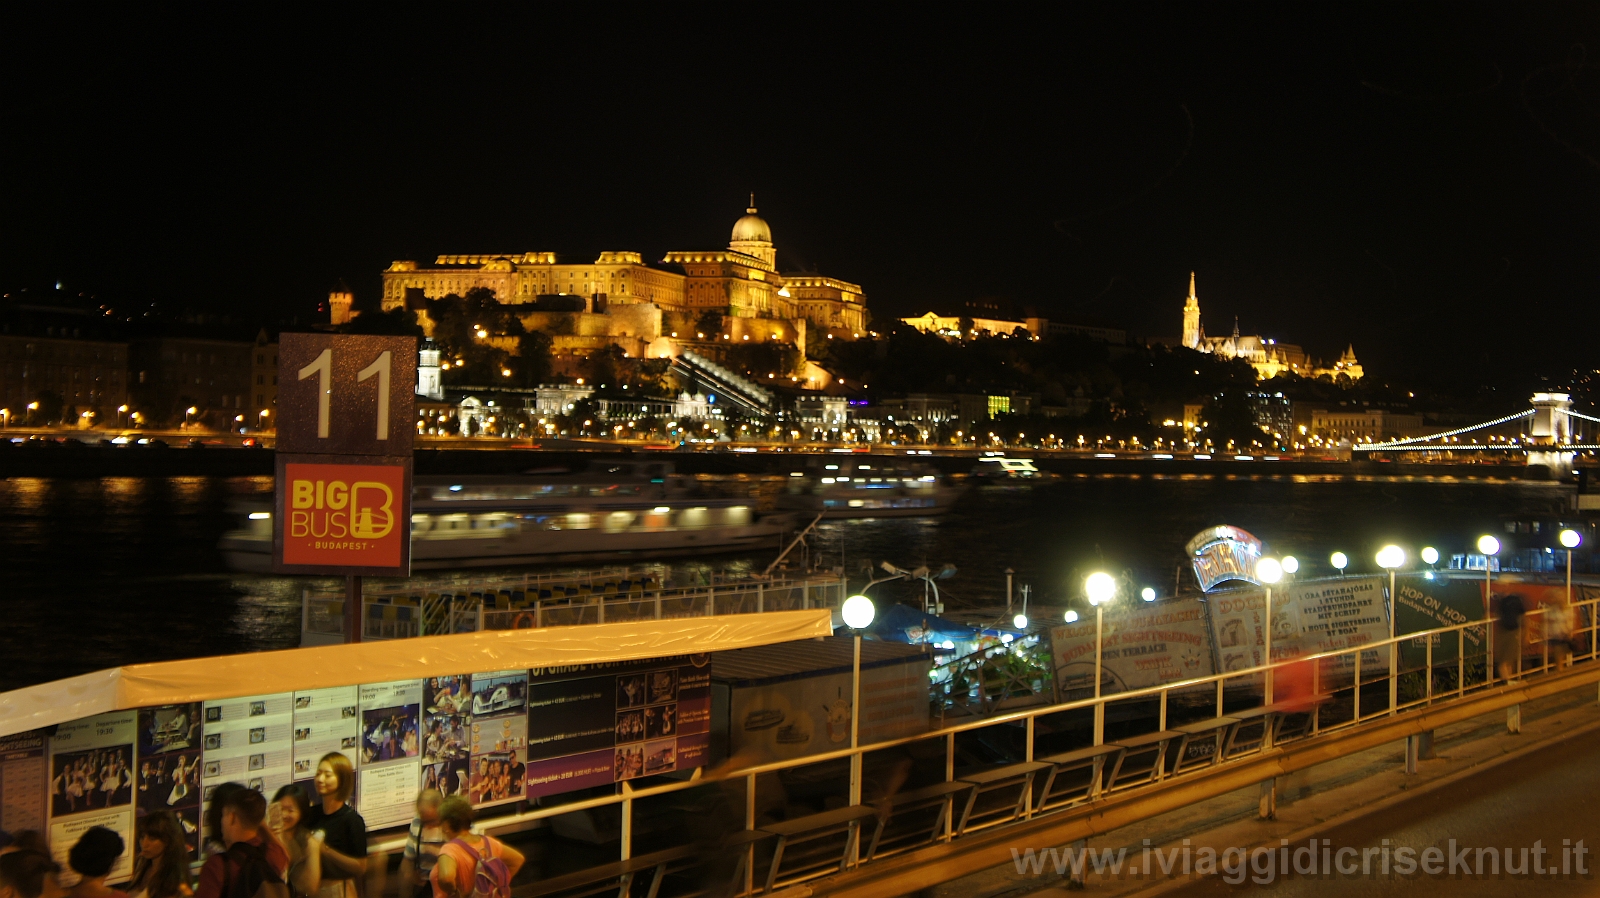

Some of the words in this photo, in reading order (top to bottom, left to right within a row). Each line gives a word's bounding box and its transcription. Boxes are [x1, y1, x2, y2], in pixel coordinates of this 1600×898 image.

[298, 349, 391, 441] 11
[292, 480, 348, 510] BIG
[291, 511, 347, 539] BUS
[315, 541, 368, 551] BUDAPEST
[1399, 596, 1434, 618] Budapest
[1401, 586, 1424, 600] HOP
[1424, 596, 1442, 611] ON
[1443, 606, 1466, 623] HOP
[1122, 630, 1202, 647] SIGHTSEEING
[1338, 628, 1358, 636] BOAT
[1123, 643, 1168, 658] TERRACE
